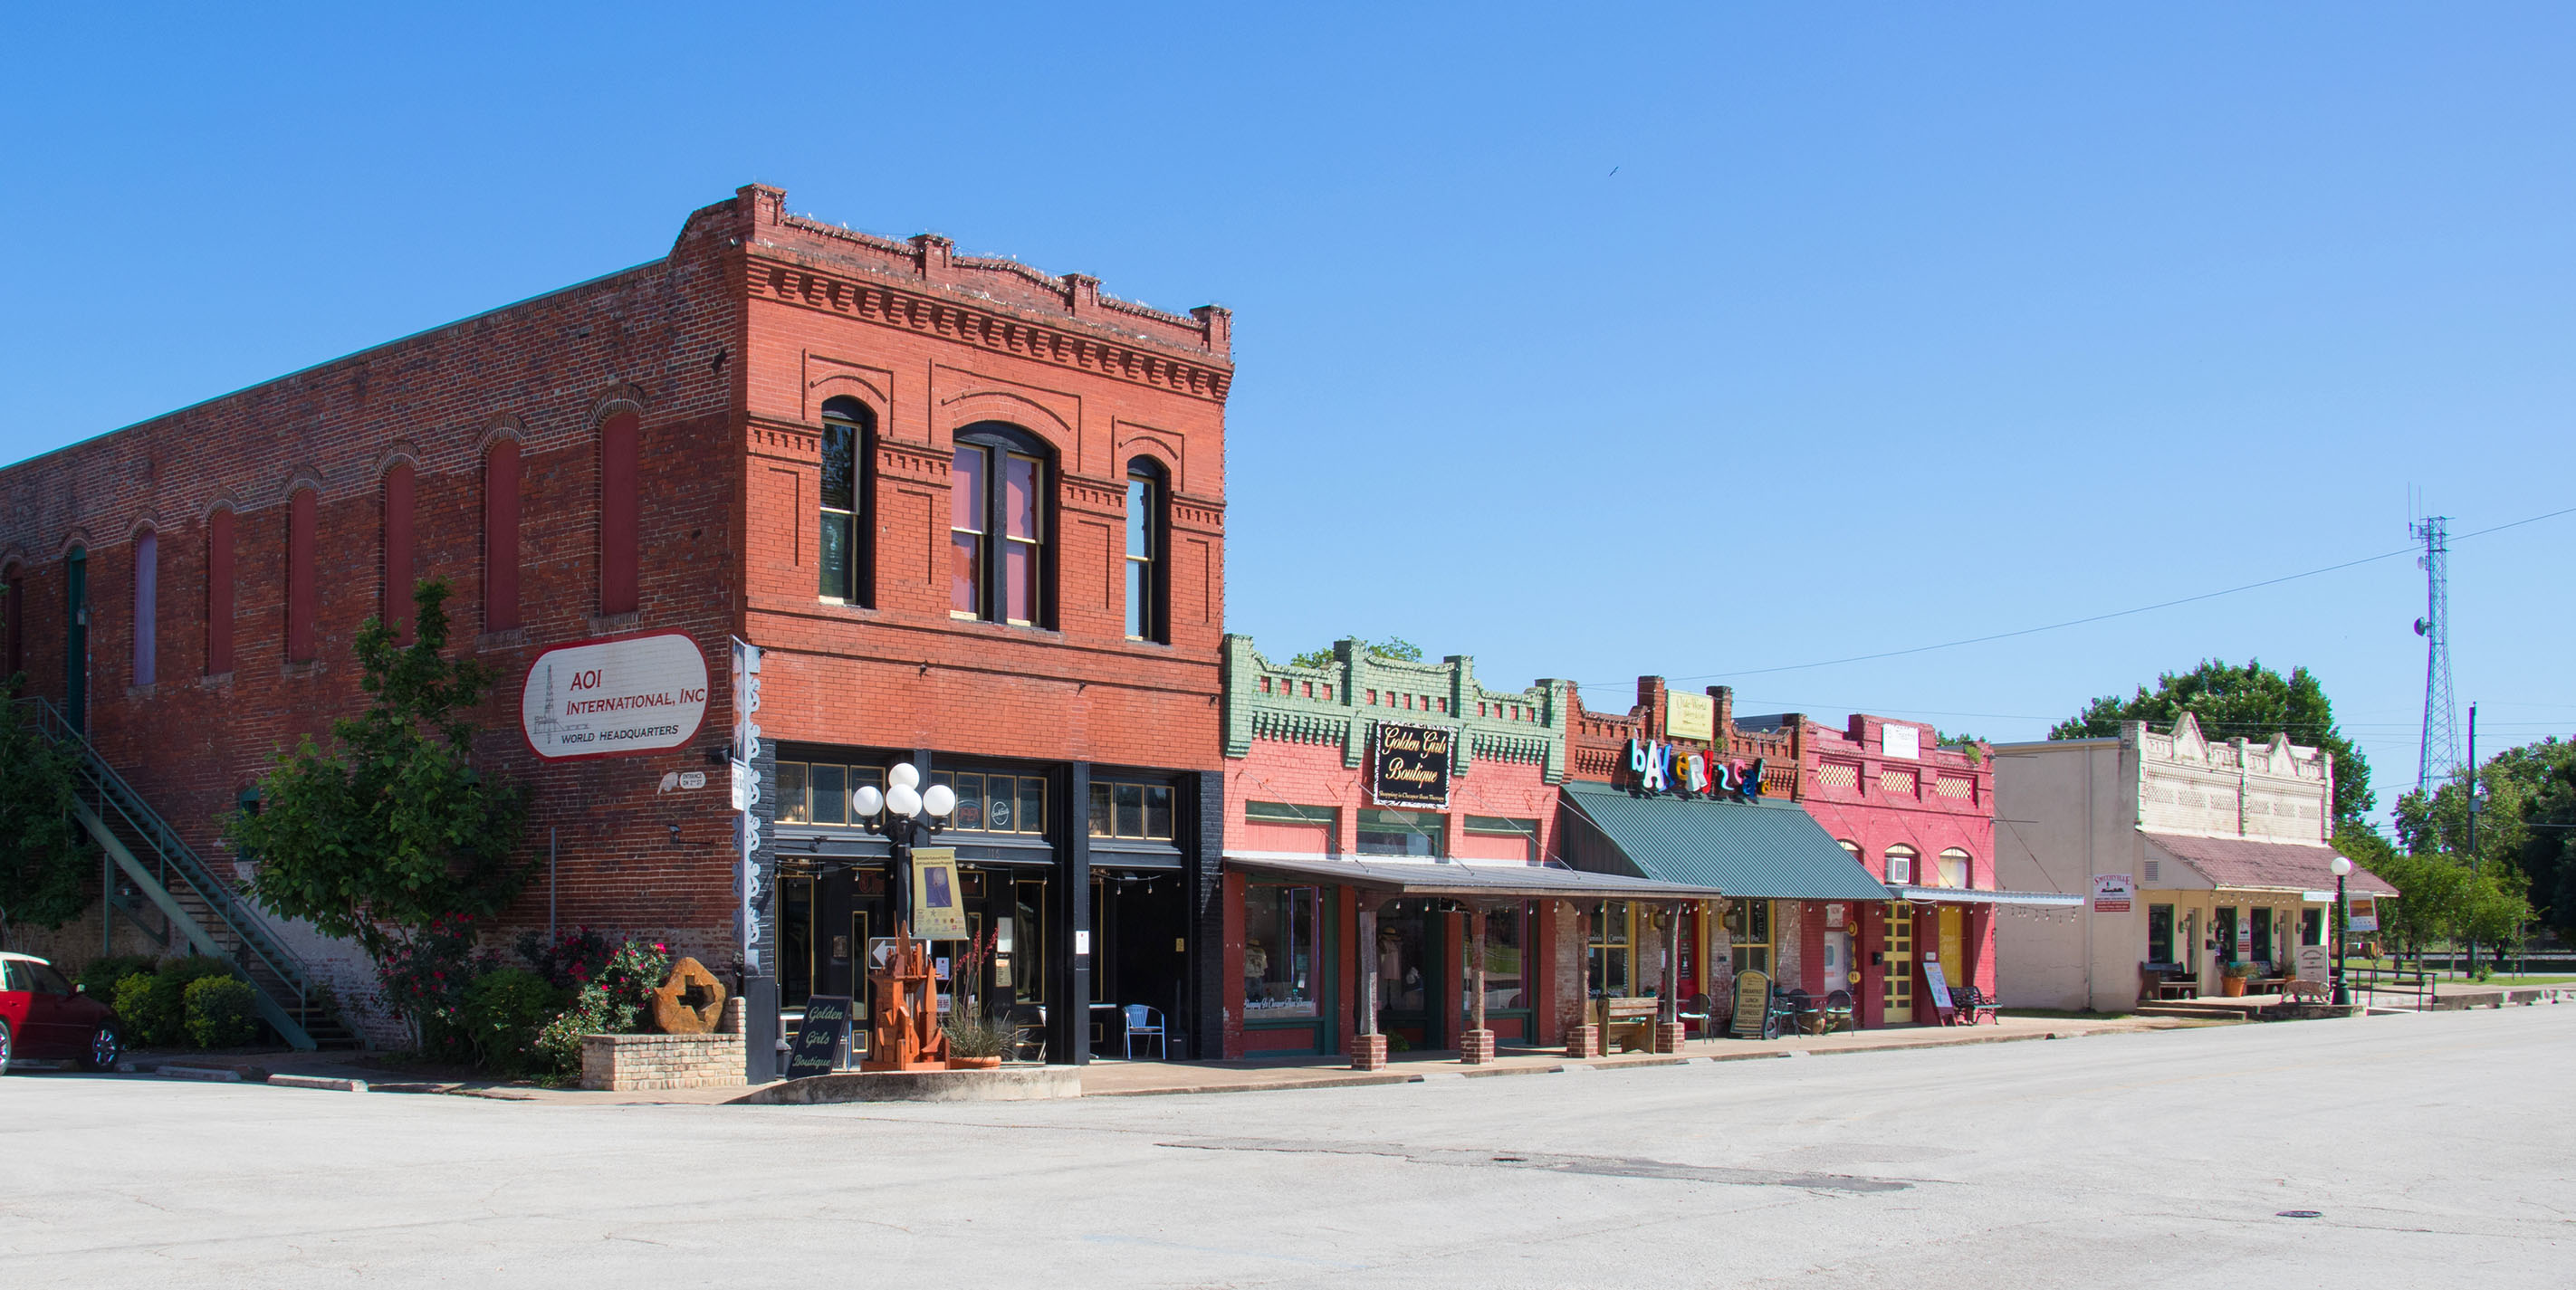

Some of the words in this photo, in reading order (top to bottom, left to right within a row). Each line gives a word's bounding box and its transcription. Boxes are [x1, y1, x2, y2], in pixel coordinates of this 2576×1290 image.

[570, 669, 602, 691] AOI
[566, 692, 675, 715] INTERNATIONAL,
[679, 688, 705, 703] INC
[560, 732, 595, 744] WORLD
[599, 725, 679, 741] HEADQUARTERS
[1381, 726, 1421, 755] Golden
[1420, 731, 1447, 759] Girls
[1384, 757, 1438, 789] Boutique
[808, 1005, 844, 1024] Golden
[805, 1030, 830, 1048] Girls
[791, 1054, 831, 1069] Boutique
